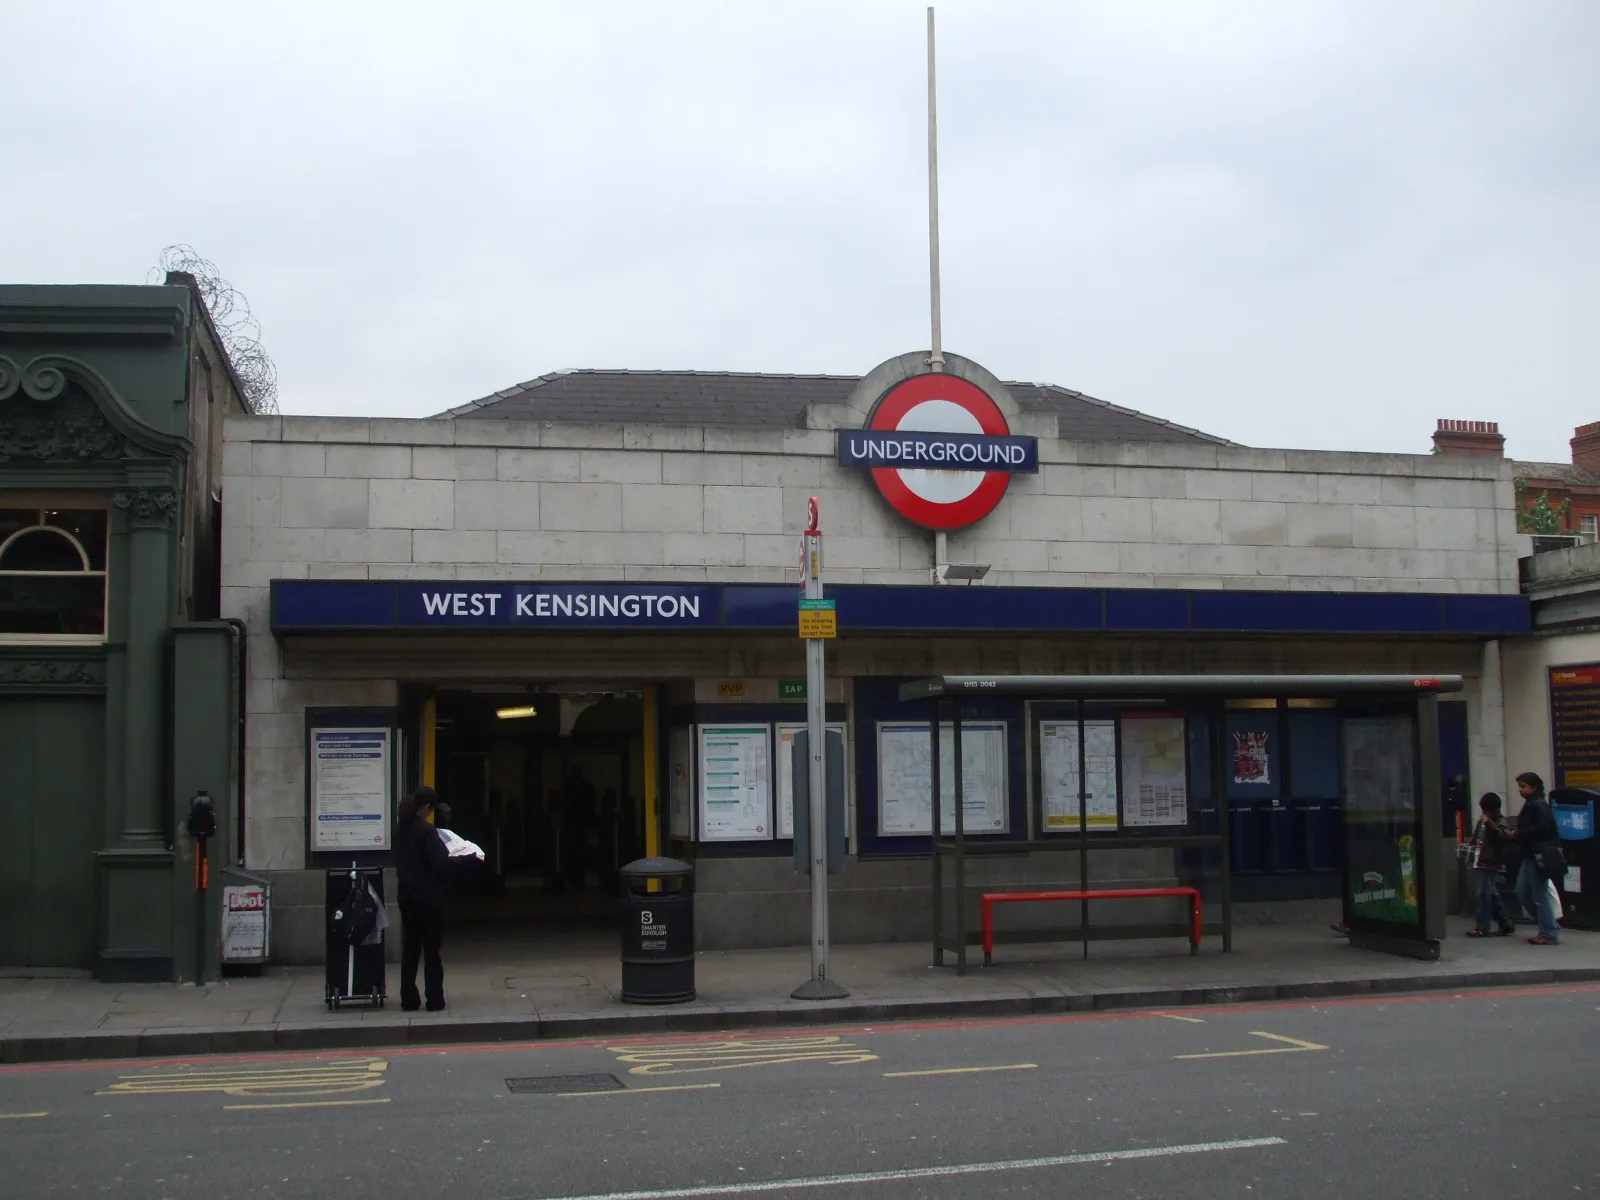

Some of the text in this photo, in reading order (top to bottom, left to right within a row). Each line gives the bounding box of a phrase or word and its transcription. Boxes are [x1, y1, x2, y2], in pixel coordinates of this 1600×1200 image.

[851, 439, 1026, 464] UNDERGROUND
[422, 593, 700, 618] WEST KENSINGTON
[720, 683, 742, 693] RVP
[784, 685, 802, 693] SAP
[231, 894, 265, 908] Loot
